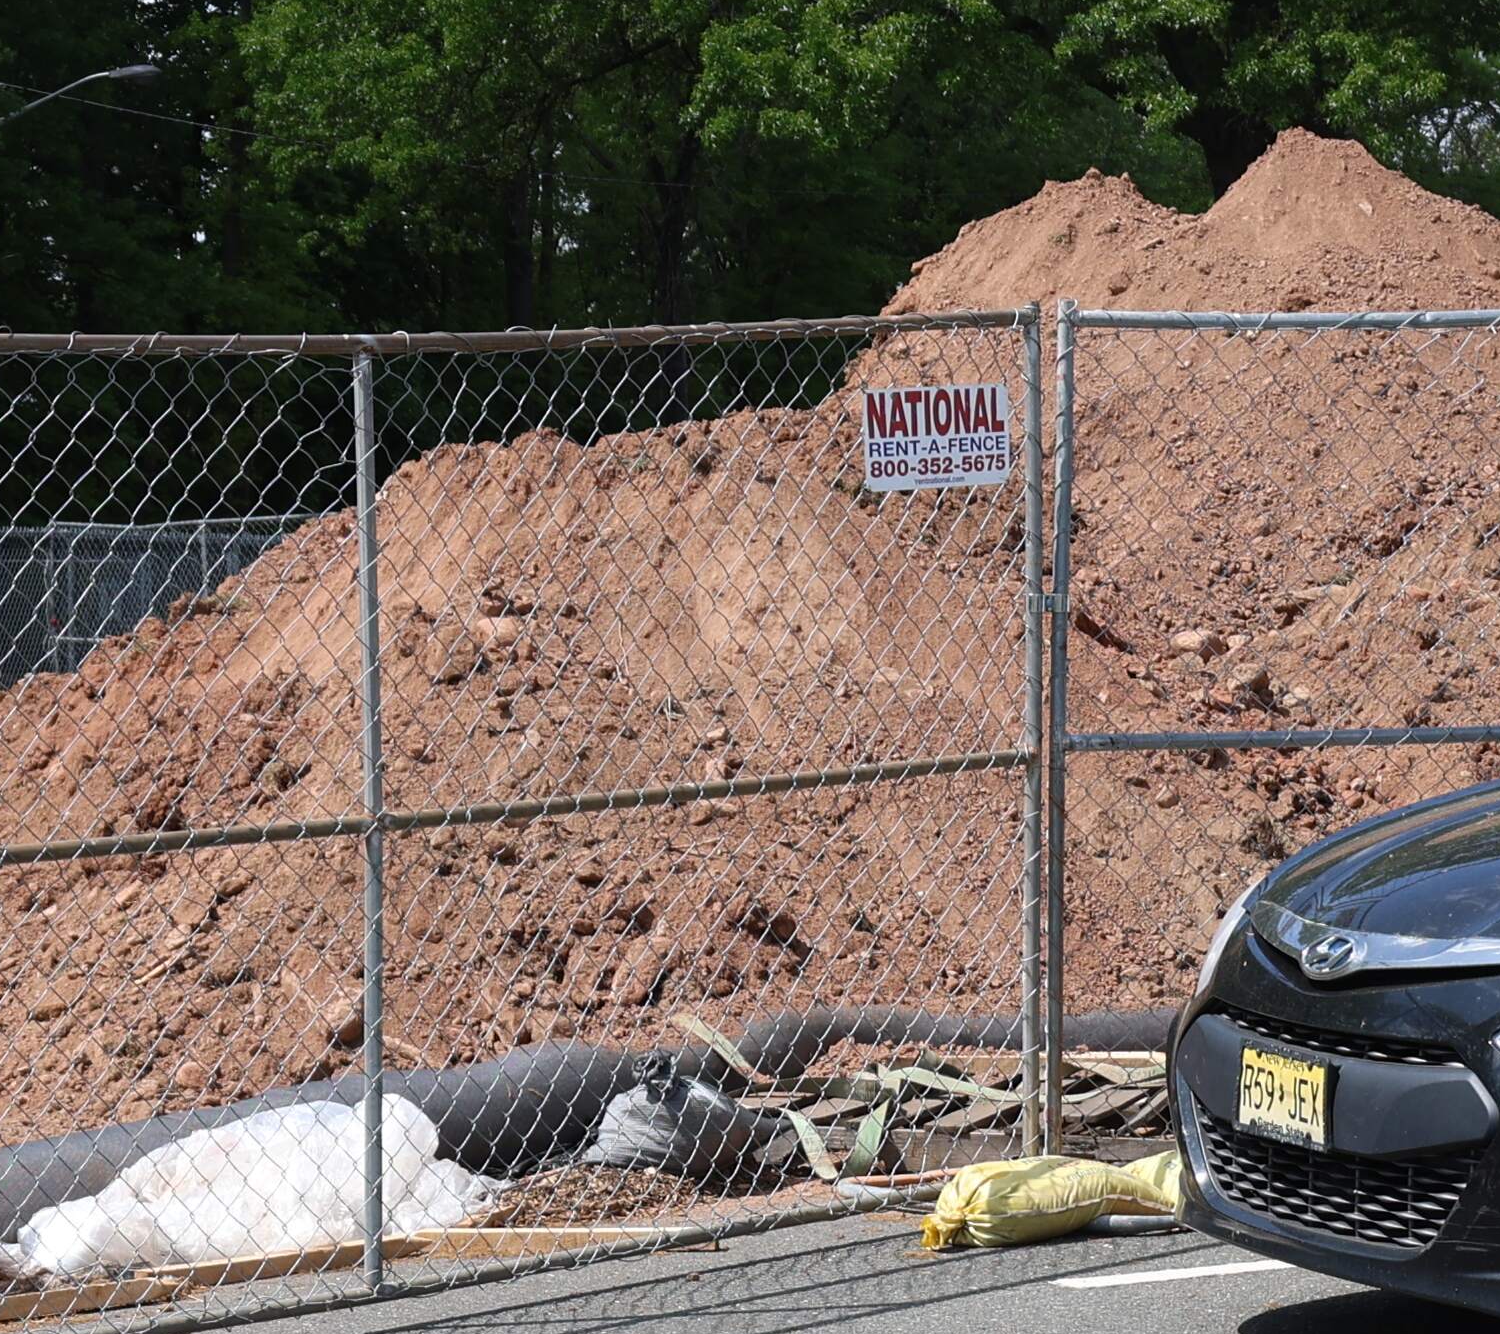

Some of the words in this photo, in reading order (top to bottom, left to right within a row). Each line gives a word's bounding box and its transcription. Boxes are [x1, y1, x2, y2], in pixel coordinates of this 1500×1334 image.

[866, 387, 1005, 439] NATIONAL
[869, 435, 1006, 458] RENT-A-FENCE
[870, 453, 1006, 479] 800-352-5675
[1287, 1076, 1320, 1127] JEX
